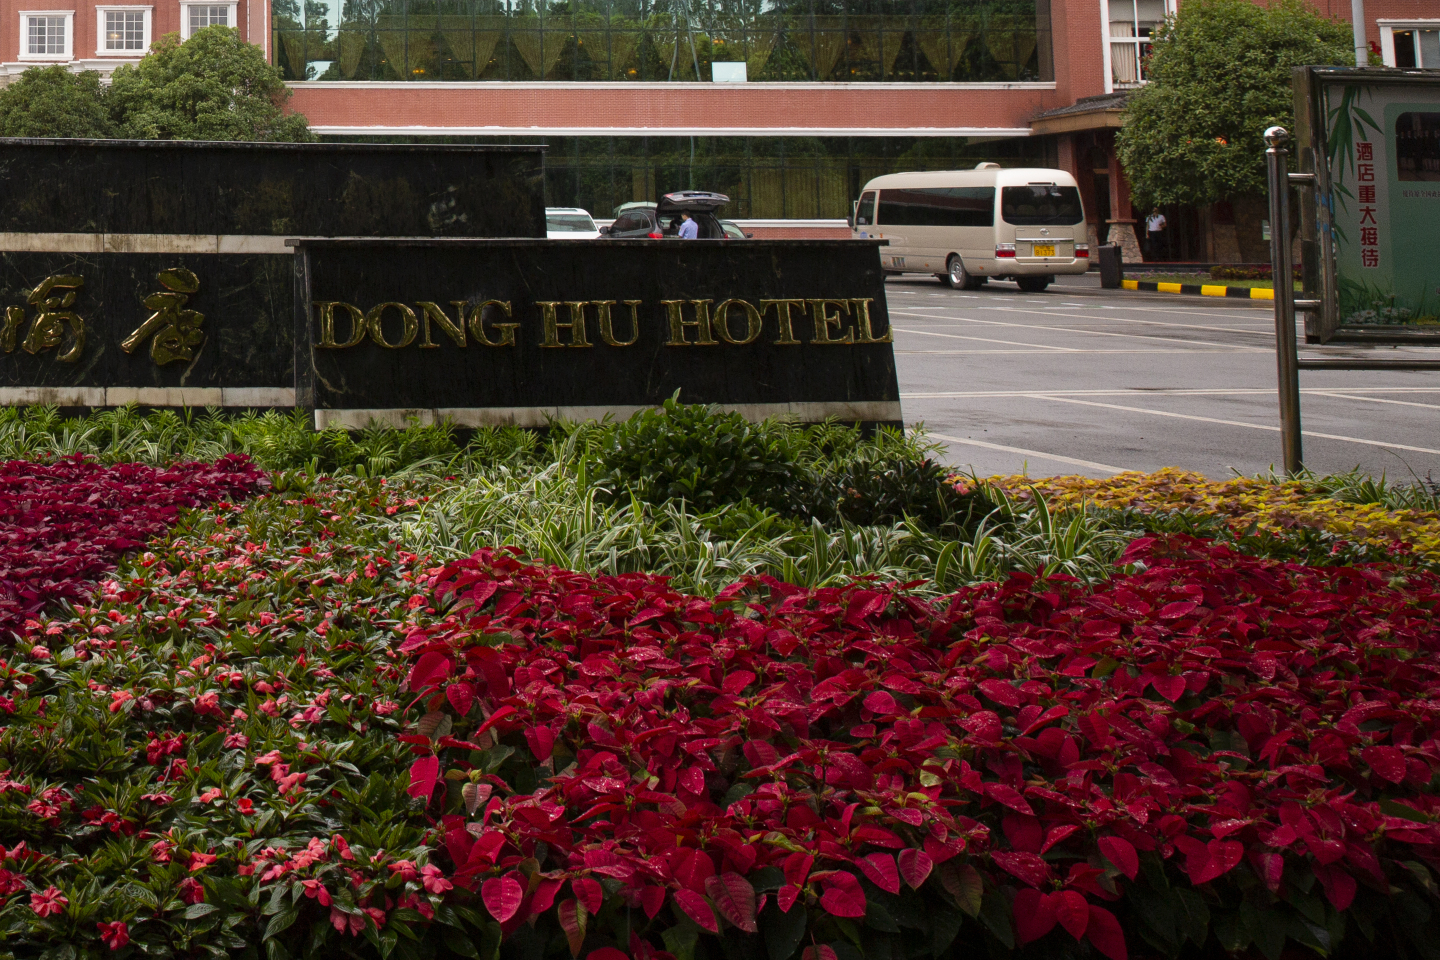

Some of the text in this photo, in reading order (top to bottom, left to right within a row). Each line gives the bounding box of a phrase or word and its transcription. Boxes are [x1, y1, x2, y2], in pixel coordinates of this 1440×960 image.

[1356, 142, 1379, 268] 酒店重大接待
[313, 297, 894, 349] DONG HU HOTEL
